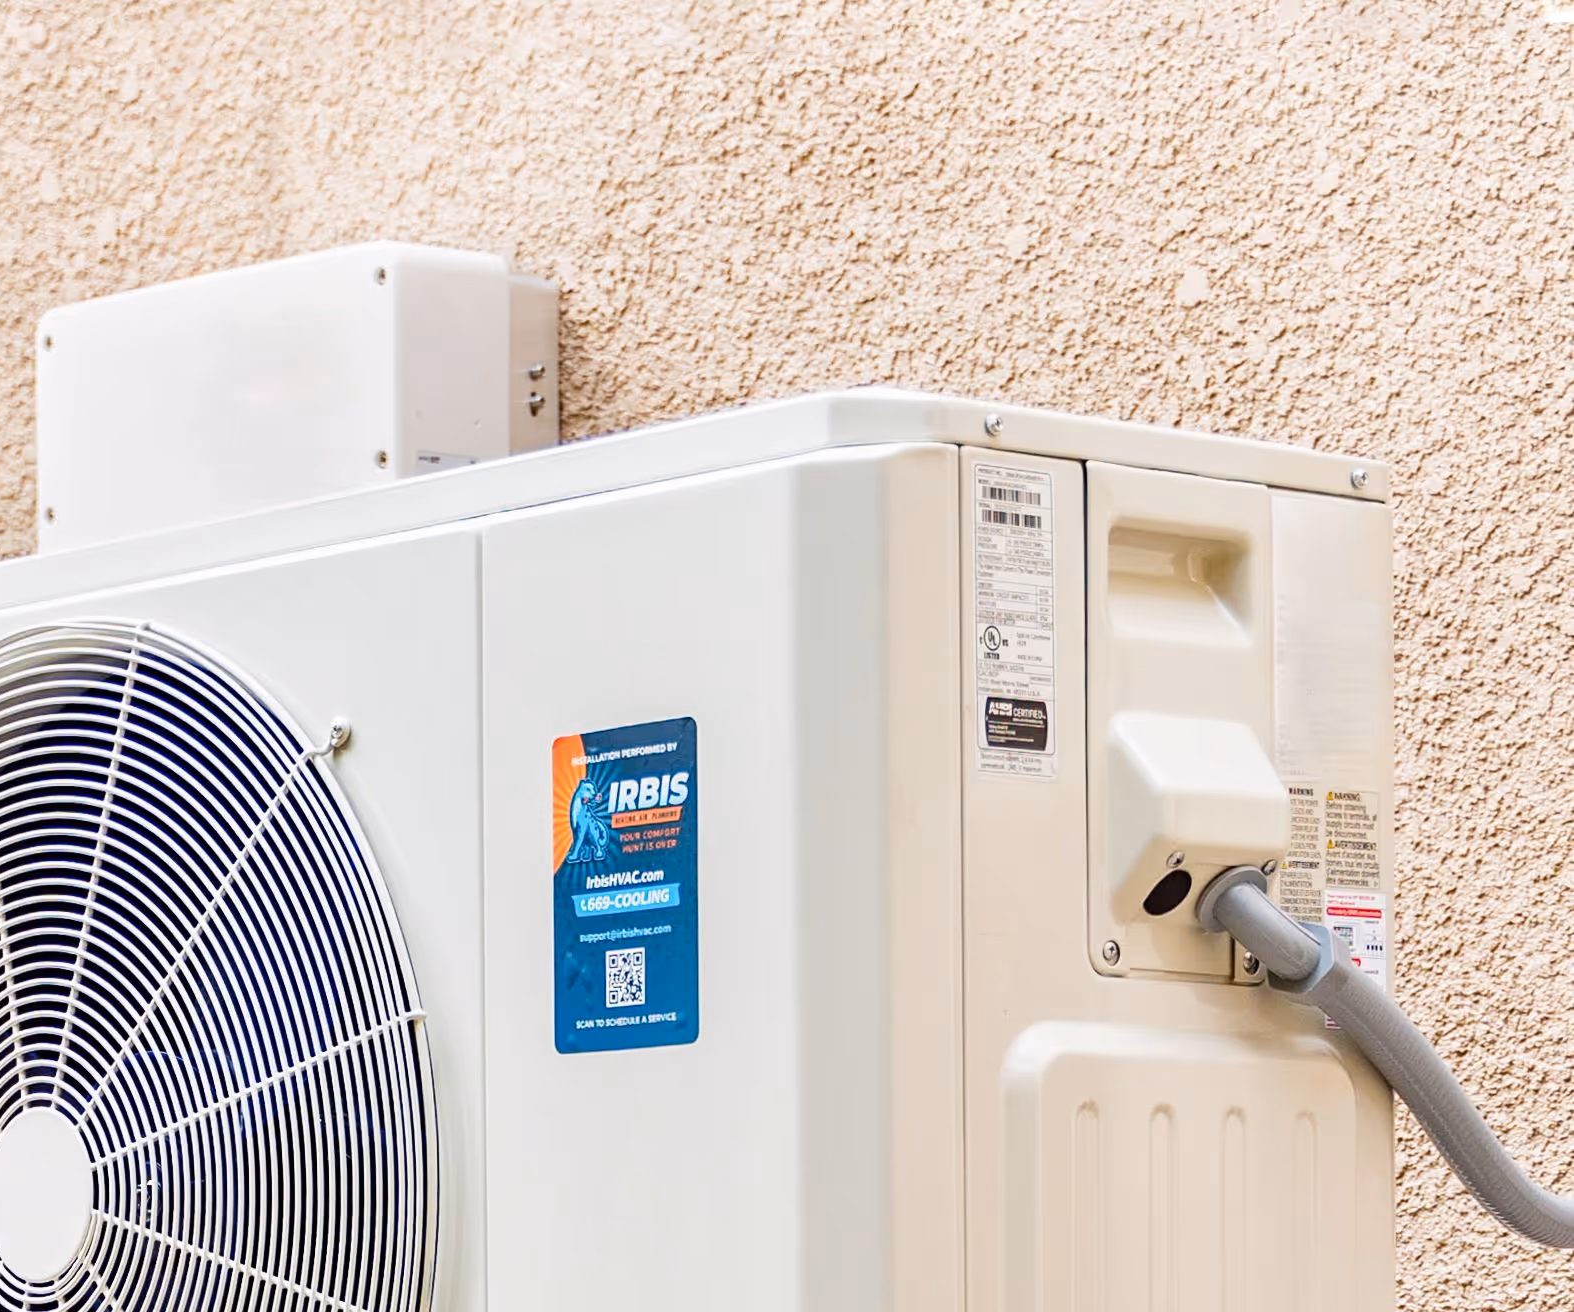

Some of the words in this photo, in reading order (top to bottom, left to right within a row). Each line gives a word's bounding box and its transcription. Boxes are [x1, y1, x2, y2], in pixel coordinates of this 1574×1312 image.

[571, 750, 621, 766] INSTALLATION
[621, 743, 666, 758] PERFORMED
[666, 742, 678, 752] BY
[607, 771, 689, 813] IRBIS
[620, 832, 641, 842] YOUR
[643, 827, 680, 839] COMFORT
[622, 843, 644, 853] HUNT
[646, 842, 655, 851] IS
[655, 839, 677, 849] OVER
[586, 870, 664, 889] IrbisHVAC.com
[587, 888, 670, 911] 669-COOLING
[580, 925, 672, 943] support@irbishvac.com
[576, 1020, 594, 1029] SCAN
[596, 1019, 604, 1028] TO
[606, 1015, 640, 1027] SCHEDULE
[648, 1012, 676, 1023] SERVICE
